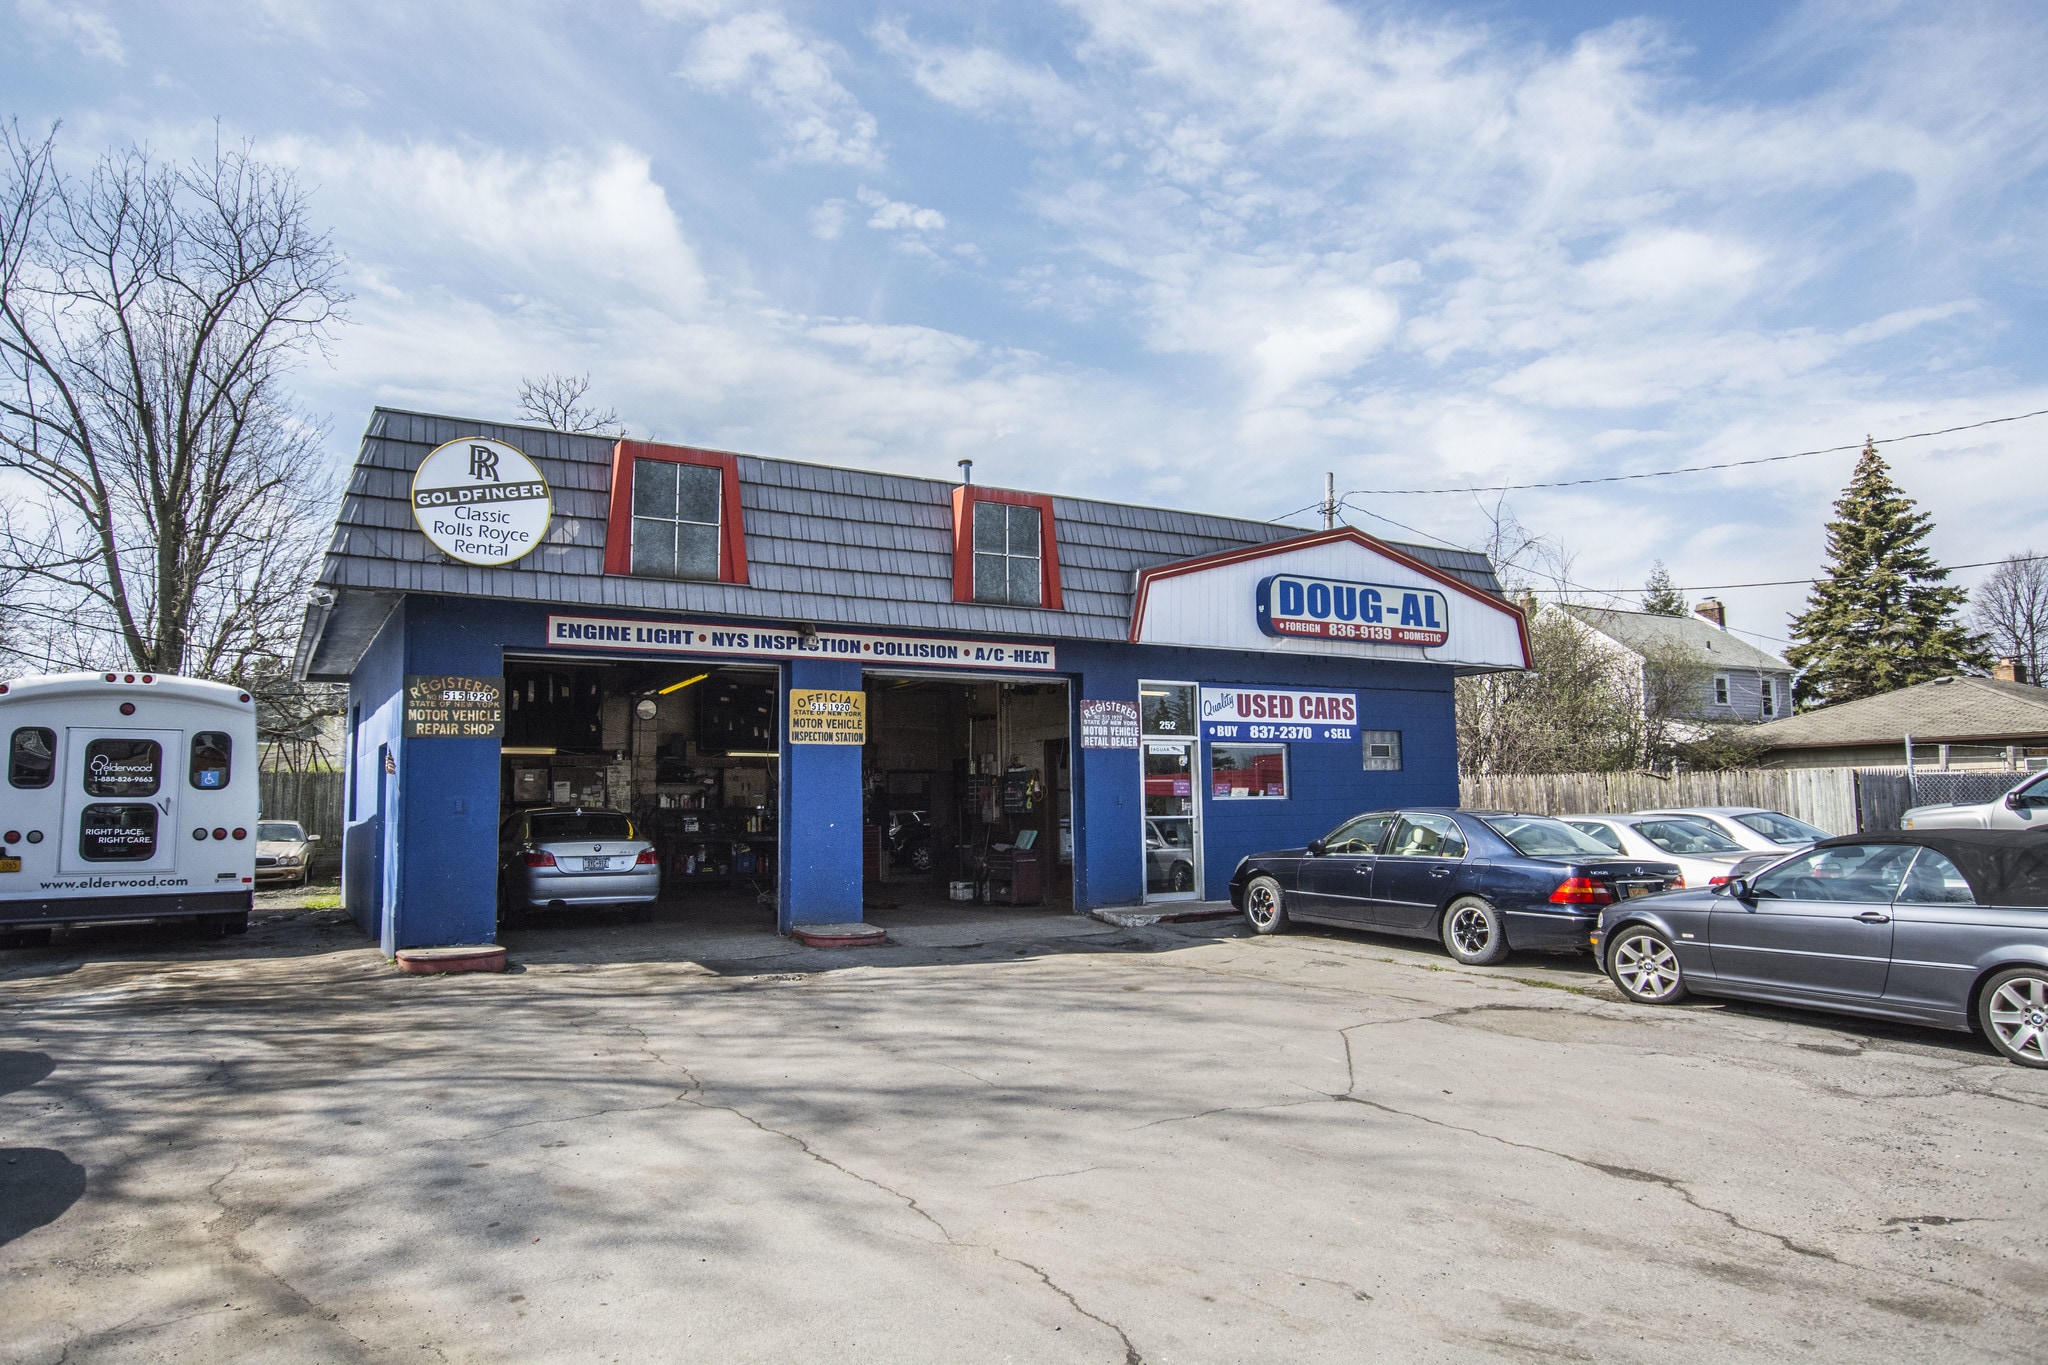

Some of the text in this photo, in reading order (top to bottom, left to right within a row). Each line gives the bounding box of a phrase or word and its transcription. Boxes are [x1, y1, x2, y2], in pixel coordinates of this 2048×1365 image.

[416, 484, 545, 505] GOLDFINGER
[454, 506, 511, 524] Classic
[433, 520, 529, 544] Rolls Royce
[454, 539, 508, 557] Rental
[1279, 580, 1441, 629] DOUG-AL
[1285, 621, 1442, 643] FOREIGN 836-9139 DOMESTIC
[556, 622, 631, 642] ENGINE
[636, 627, 694, 645] LIGHT
[711, 631, 749, 649] NYS
[873, 641, 958, 659] COLLISION
[975, 647, 1004, 662] A/C
[409, 677, 500, 699] REGISTERED
[409, 700, 436, 708] STATE
[439, 700, 451, 708] OF
[797, 693, 860, 710] OFFICIAL
[1203, 692, 1355, 721] Quality USED CARS
[408, 709, 501, 722] MOTOR VEHICLE
[1083, 701, 1138, 720] REGISTERED
[416, 723, 495, 735] REPAIR SHOP
[793, 718, 862, 729] MOTOR VEHICLE
[1159, 720, 1176, 730] 252
[792, 731, 864, 743] INSPECTION STATION
[1082, 725, 1140, 737] MOTOR VEHICLE
[1216, 725, 1352, 739] BUY 837-2370 SELL
[1084, 736, 1138, 747] RETAIL DEALER
[103, 762, 153, 772] elderwood
[85, 828, 112, 836] RIGHT
[98, 836, 153, 844] RIGHT CARE.
[40, 875, 188, 890] www.elderwood.com
